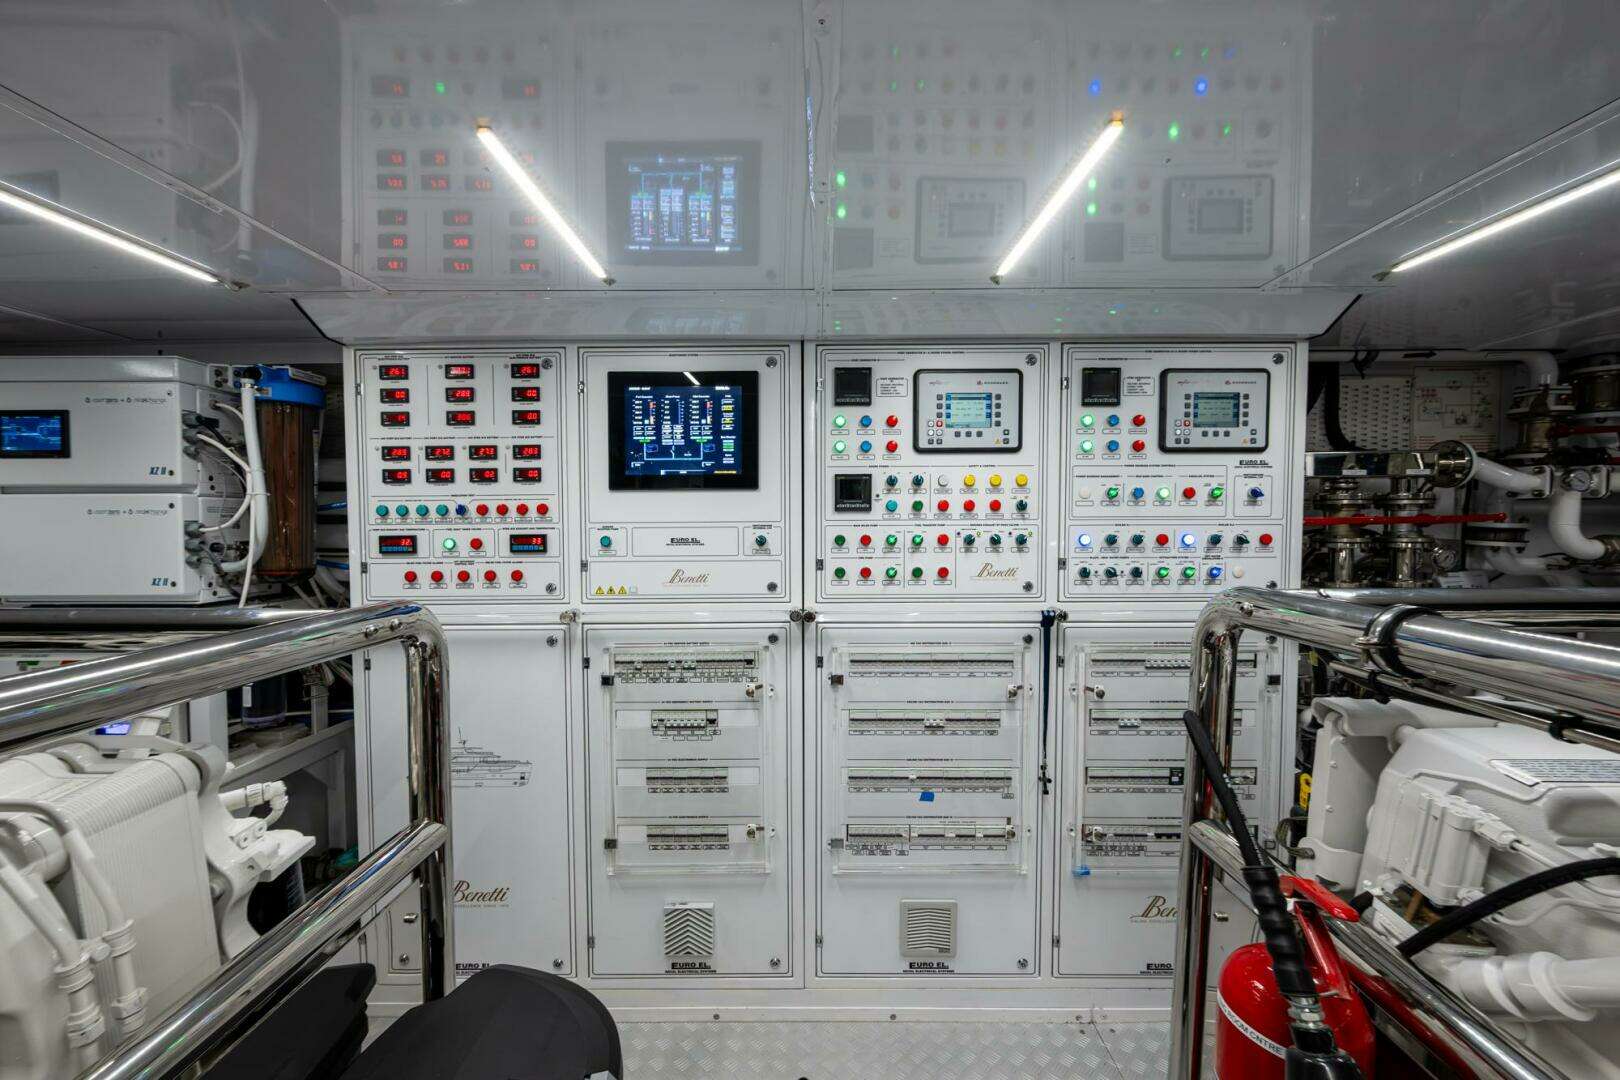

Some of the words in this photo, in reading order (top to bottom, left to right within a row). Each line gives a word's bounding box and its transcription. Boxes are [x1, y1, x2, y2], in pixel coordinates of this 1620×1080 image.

[668, 568, 710, 584] Benetti
[976, 562, 1019, 578] Benetti
[454, 880, 510, 903] Benetti
